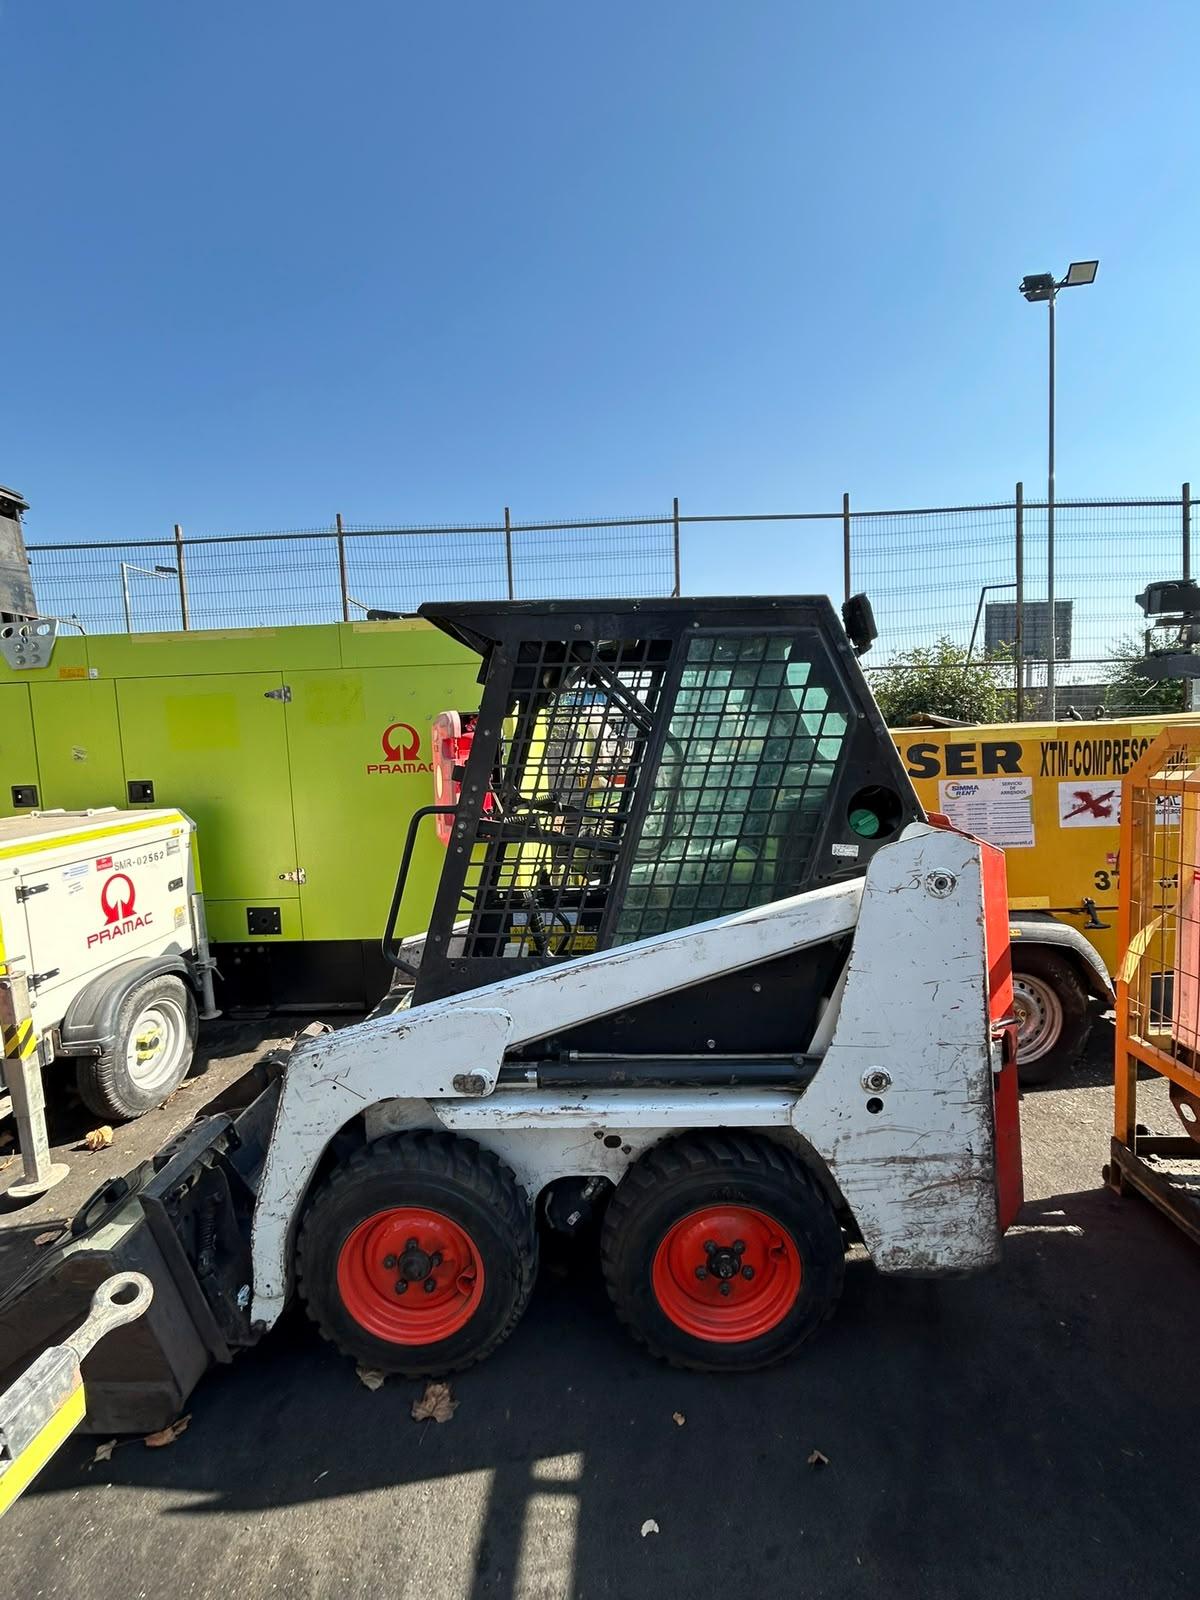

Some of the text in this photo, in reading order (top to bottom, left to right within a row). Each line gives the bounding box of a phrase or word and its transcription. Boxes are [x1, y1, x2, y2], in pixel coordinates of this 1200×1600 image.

[899, 741, 1023, 779] SER
[1040, 738, 1155, 777] XTM-COMPRES
[87, 912, 153, 949] PRAMAC
